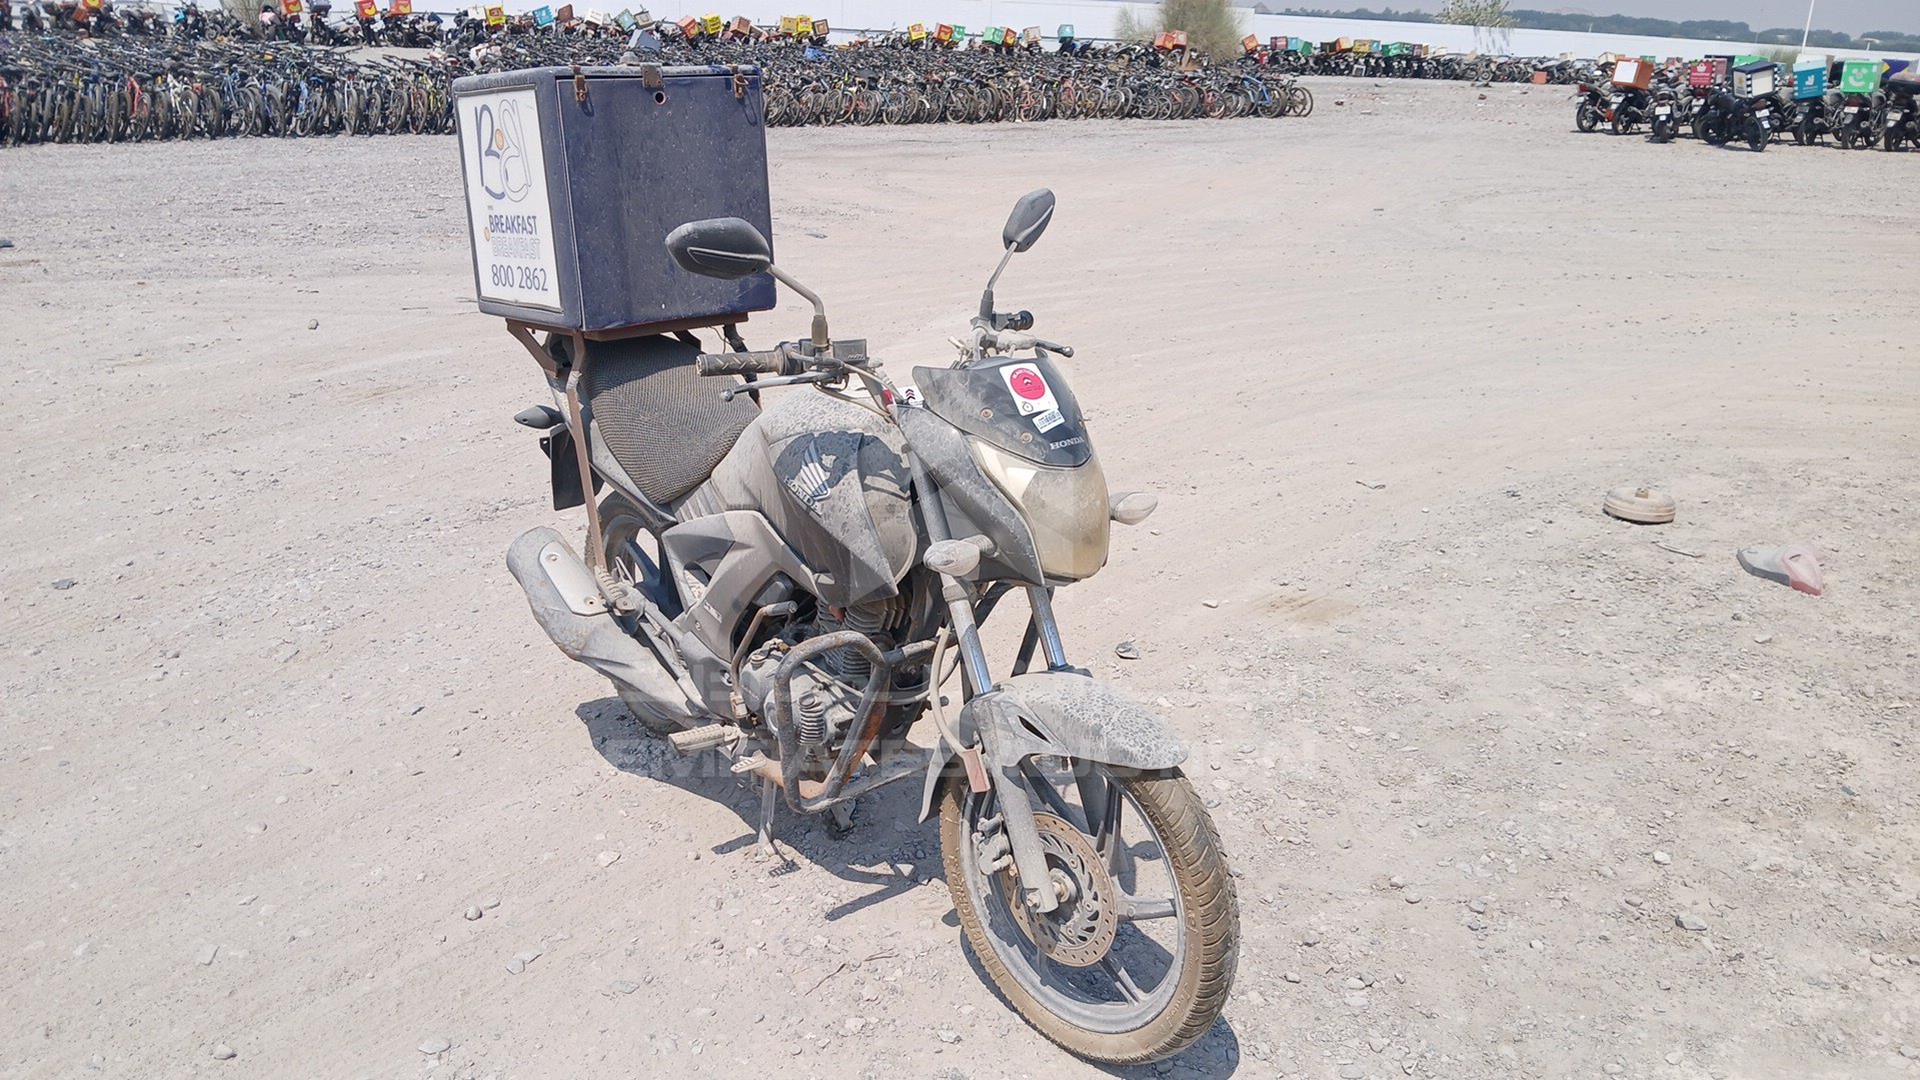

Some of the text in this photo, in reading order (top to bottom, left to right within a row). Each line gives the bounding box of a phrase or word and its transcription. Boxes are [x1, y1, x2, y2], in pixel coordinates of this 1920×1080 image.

[488, 214, 538, 235] BREAKFAST
[491, 264, 549, 291] 800 2862
[1049, 435, 1085, 450] HONDA
